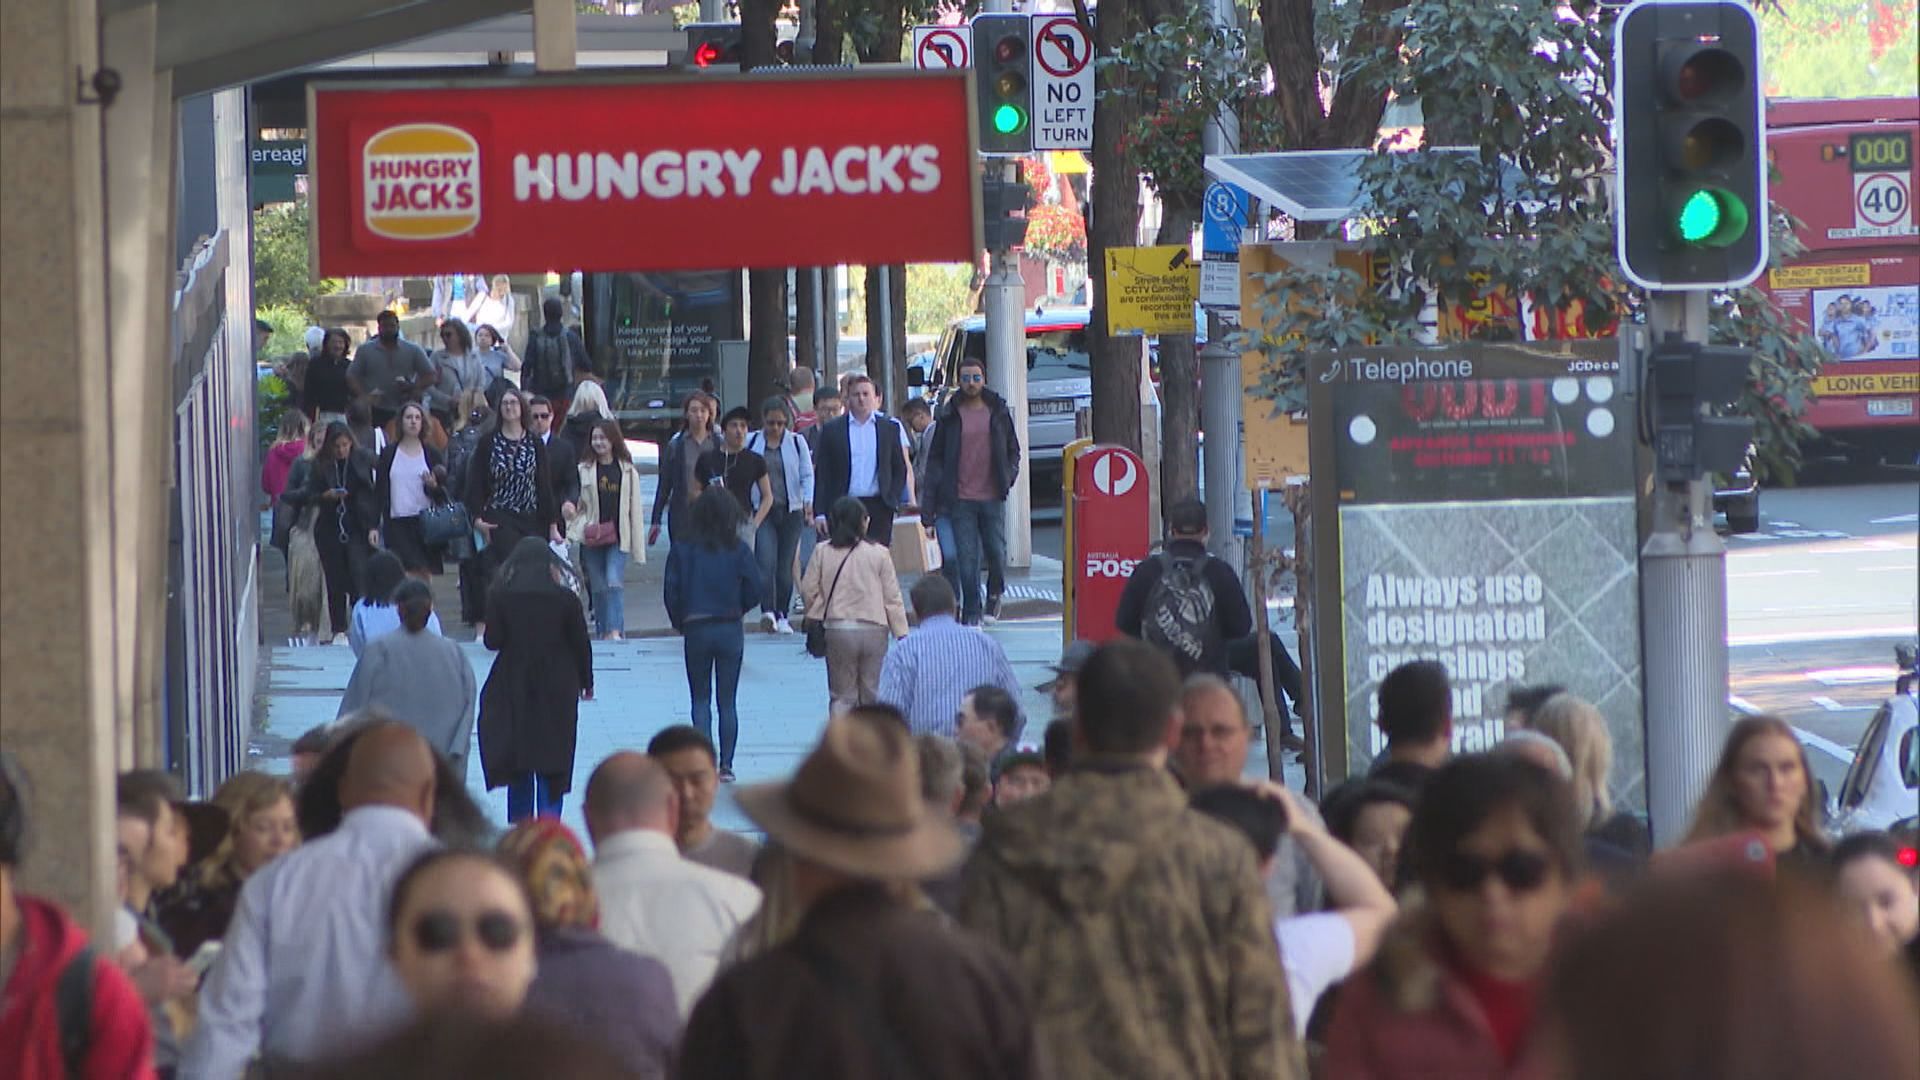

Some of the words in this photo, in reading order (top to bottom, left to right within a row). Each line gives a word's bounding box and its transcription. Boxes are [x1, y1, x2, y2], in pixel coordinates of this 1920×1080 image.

[1047, 82, 1081, 103] NO
[1044, 108, 1086, 123] LEFT
[1042, 128, 1088, 141] TURN
[1855, 138, 1906, 165] 000
[370, 158, 472, 180] HUNGRY
[513, 149, 761, 200] HUNGRY
[770, 144, 941, 196] JACK'S
[1864, 186, 1903, 213] 40
[1135, 276, 1159, 285] Street
[1162, 275, 1189, 284] Safety
[1124, 286, 1150, 294] CCTV
[1152, 284, 1190, 294] Cameras
[1120, 296, 1134, 304] are
[1136, 294, 1191, 304] continuously
[1140, 303, 1181, 312] recording
[1154, 311, 1170, 320] this
[617, 326, 643, 336] Keep
[645, 327, 671, 336] more
[674, 324, 684, 333] of
[686, 325, 709, 335] your
[615, 336, 649, 347] money
[689, 335, 712, 346] your
[679, 347, 701, 355] now
[1350, 355, 1473, 385] Telephone
[1827, 376, 1875, 391] LONG
[1087, 560, 1142, 577] POS
[1366, 573, 1478, 609] Always
[1485, 573, 1543, 604] use
[1367, 605, 1546, 646] designated
